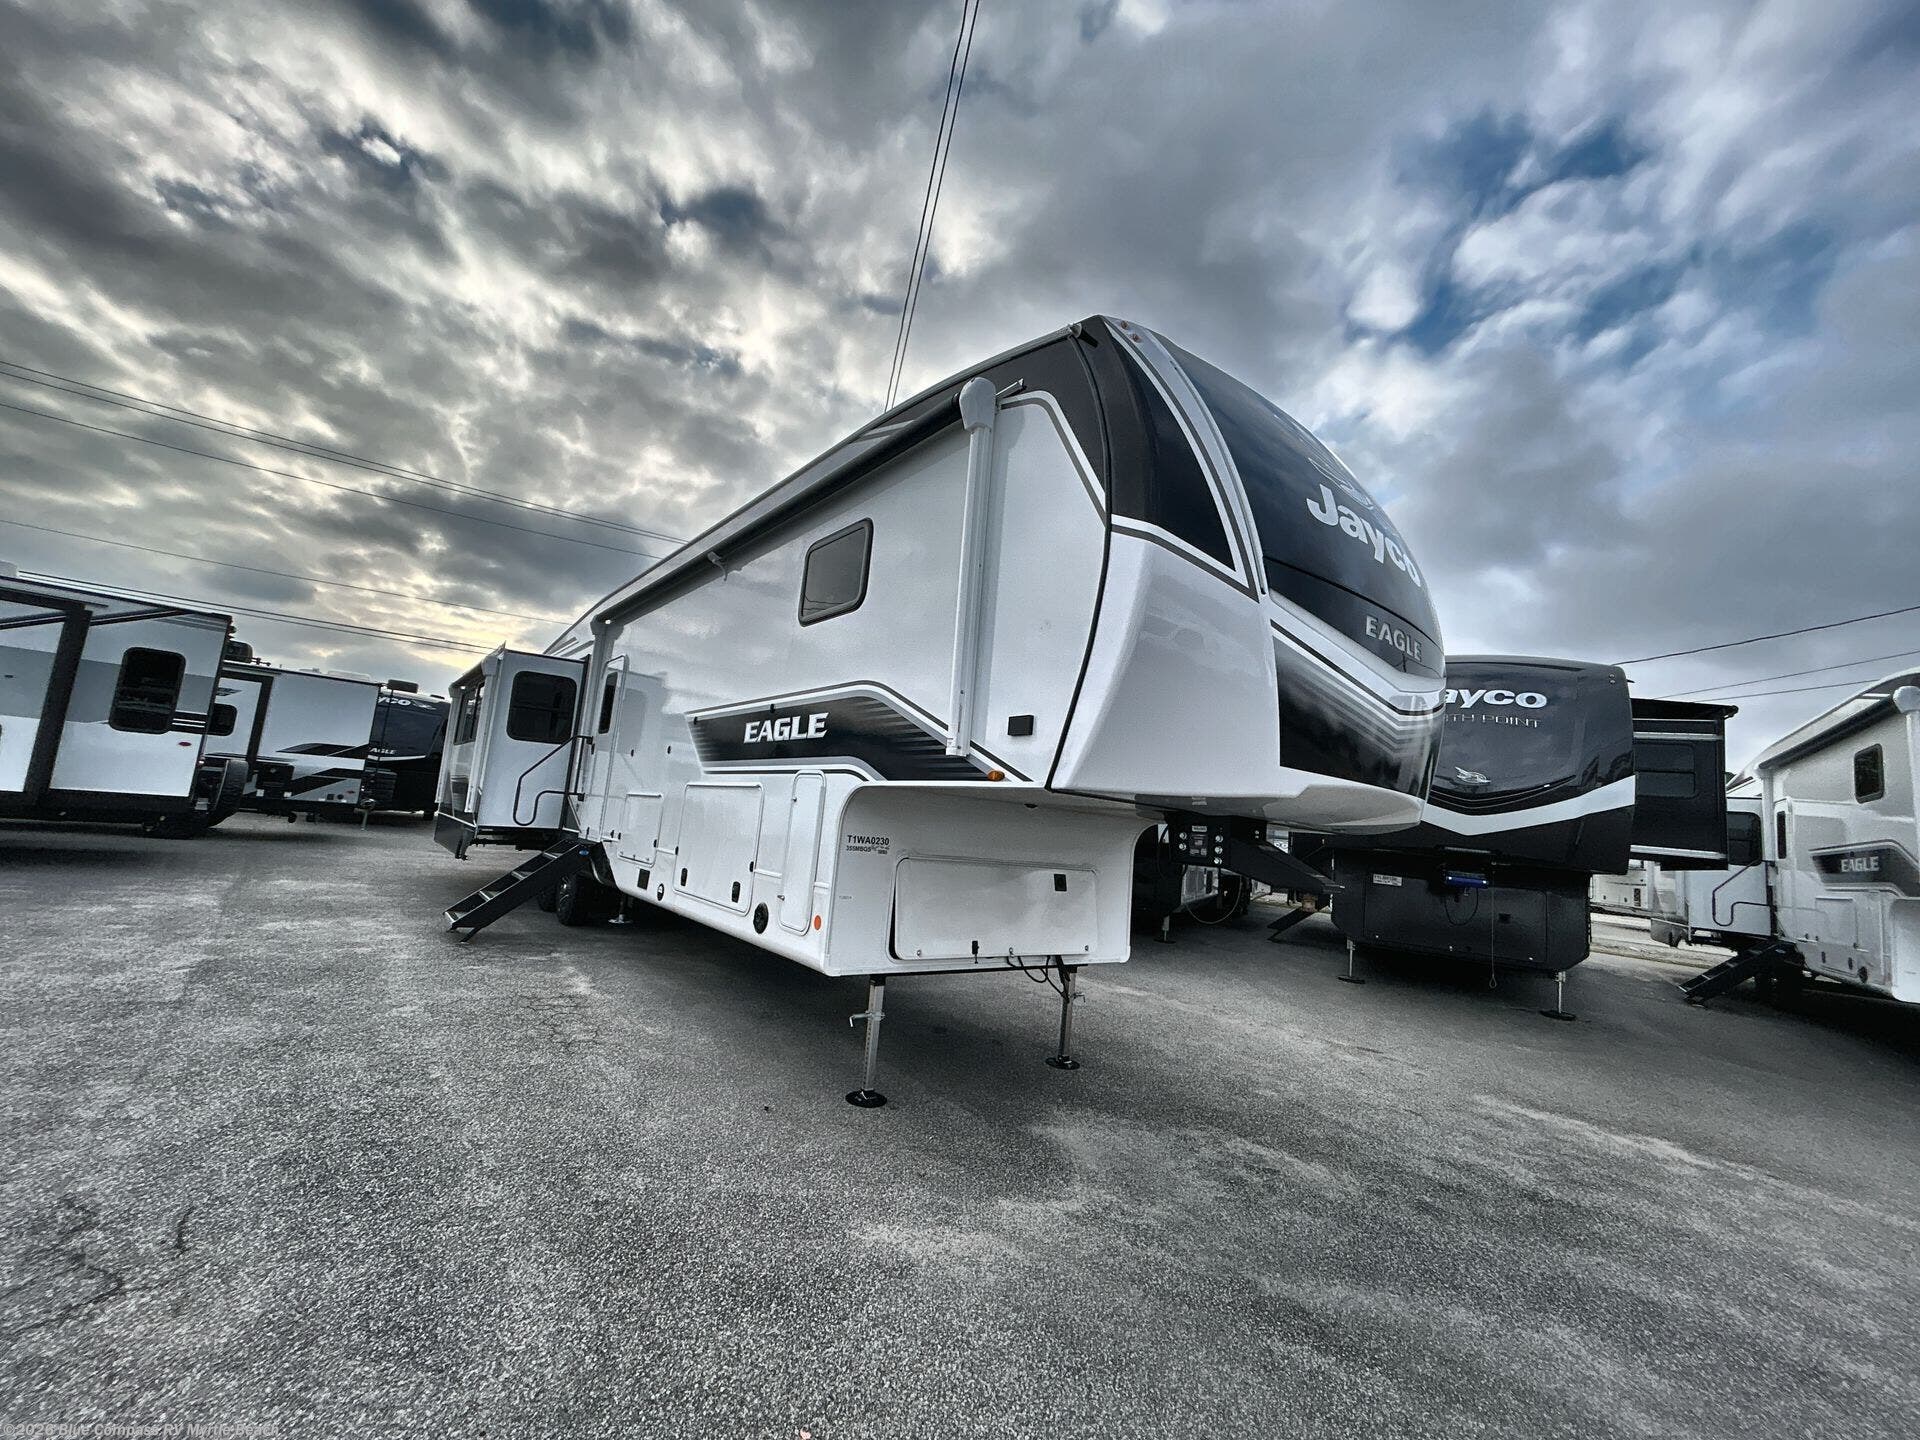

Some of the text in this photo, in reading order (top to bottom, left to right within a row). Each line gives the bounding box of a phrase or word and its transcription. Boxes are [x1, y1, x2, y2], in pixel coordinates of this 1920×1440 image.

[1306, 484, 1421, 587] Jayco
[1365, 615, 1422, 661] EAGLE
[377, 696, 411, 706] yco
[1445, 689, 1547, 709] ayco
[743, 712, 829, 744] EAGLE
[1482, 714, 1541, 728] POINT
[369, 747, 396, 755] AGLE
[847, 835, 889, 846] T1WA0230
[1841, 856, 1879, 872] EAGLE
